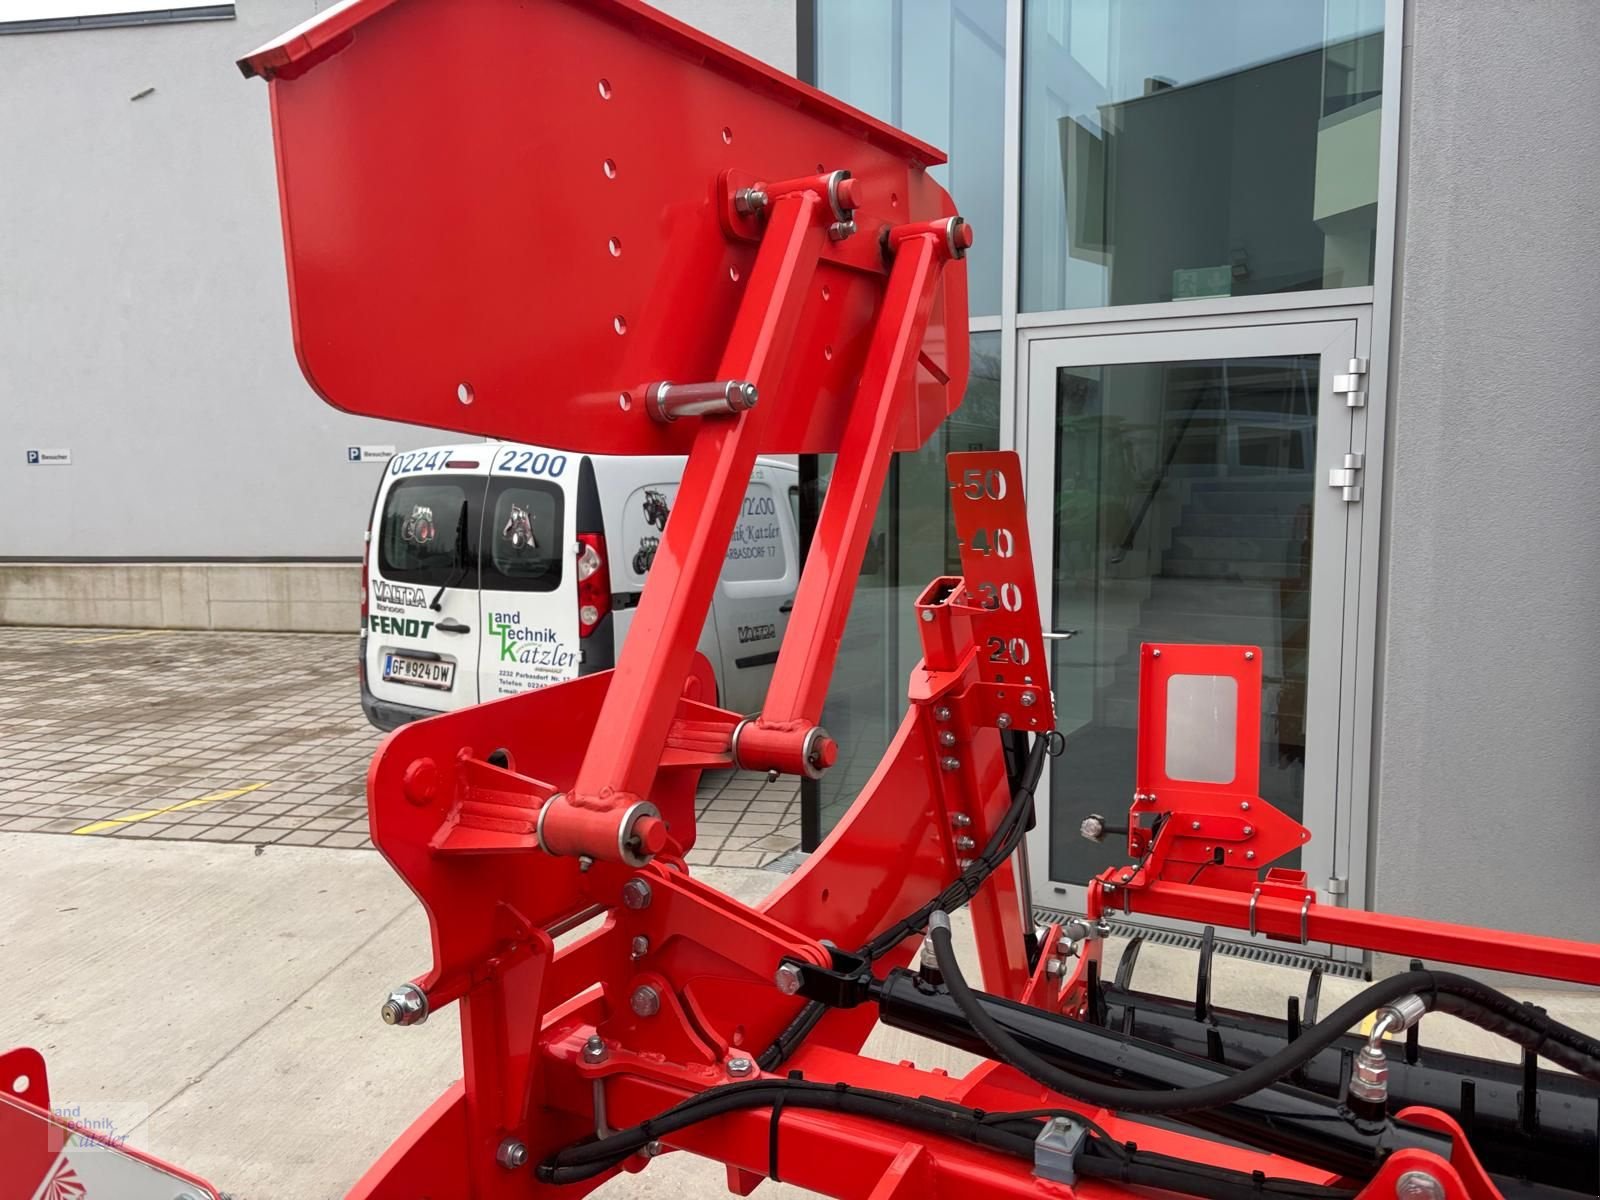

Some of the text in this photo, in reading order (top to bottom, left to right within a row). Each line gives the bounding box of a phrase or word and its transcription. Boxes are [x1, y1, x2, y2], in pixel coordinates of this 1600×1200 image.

[391, 450, 567, 478] 02247 2200
[963, 469, 1007, 500] 50
[742, 496, 776, 517] 2200
[971, 527, 1014, 558] 40
[372, 579, 428, 609] VALTRA
[978, 582, 1022, 612] 30
[370, 614, 435, 639] FENDT
[488, 611, 521, 636] Land
[496, 623, 557, 644] Technik
[737, 623, 777, 644] VALTRA
[501, 640, 577, 668] Katzler
[986, 636, 1030, 666] 20
[392, 659, 450, 682] GF 924 DW
[499, 678, 523, 687] Telefon
